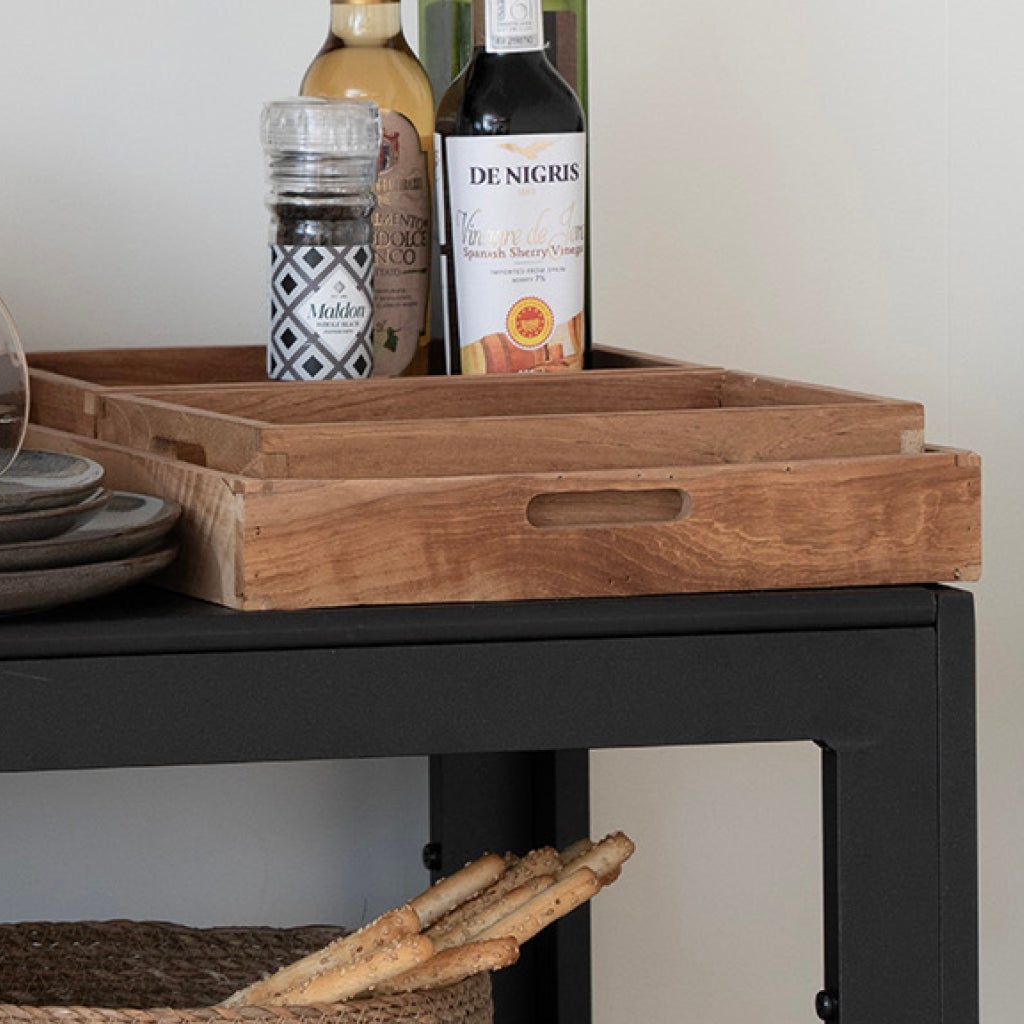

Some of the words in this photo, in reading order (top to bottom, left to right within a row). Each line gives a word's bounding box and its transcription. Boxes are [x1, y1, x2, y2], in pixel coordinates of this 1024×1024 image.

[469, 165, 501, 186] DE
[505, 162, 580, 185] NIGRIS
[463, 246, 506, 261] Spanish
[510, 245, 547, 258] Sherry
[307, 301, 365, 319] Maldon
